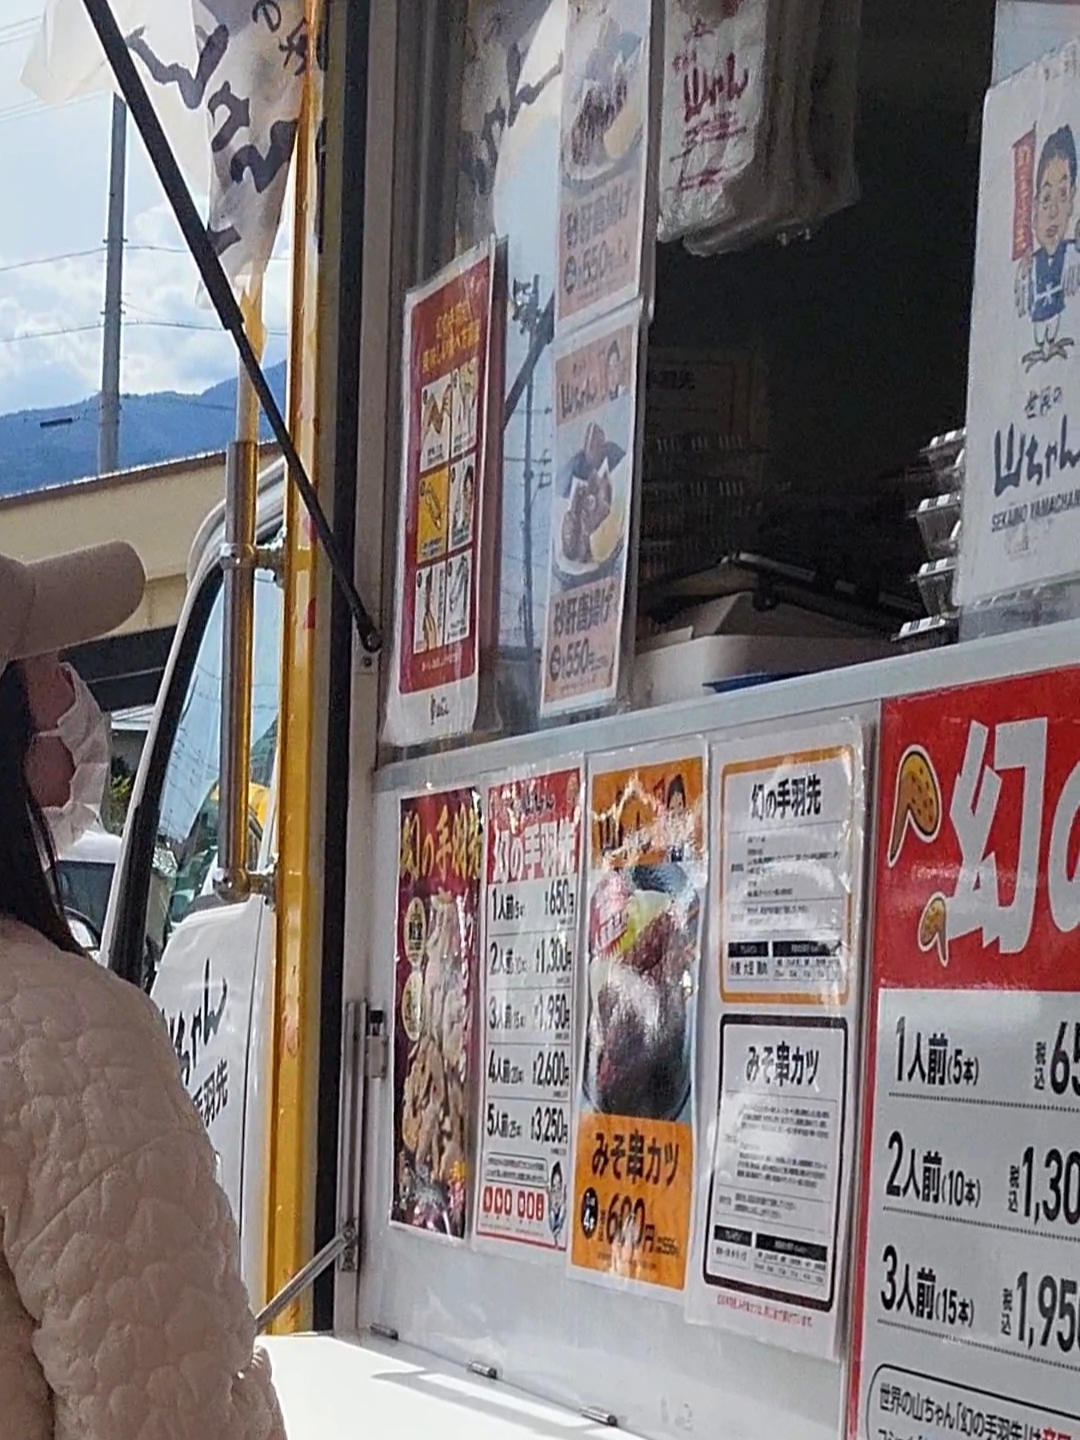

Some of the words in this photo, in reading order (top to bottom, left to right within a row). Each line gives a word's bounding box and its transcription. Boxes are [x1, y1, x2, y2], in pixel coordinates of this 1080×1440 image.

[751, 774, 822, 821] 幻の手羽先
[746, 1040, 820, 1088] みそ串カツ
[592, 1129, 680, 1187] みそ串カツ
